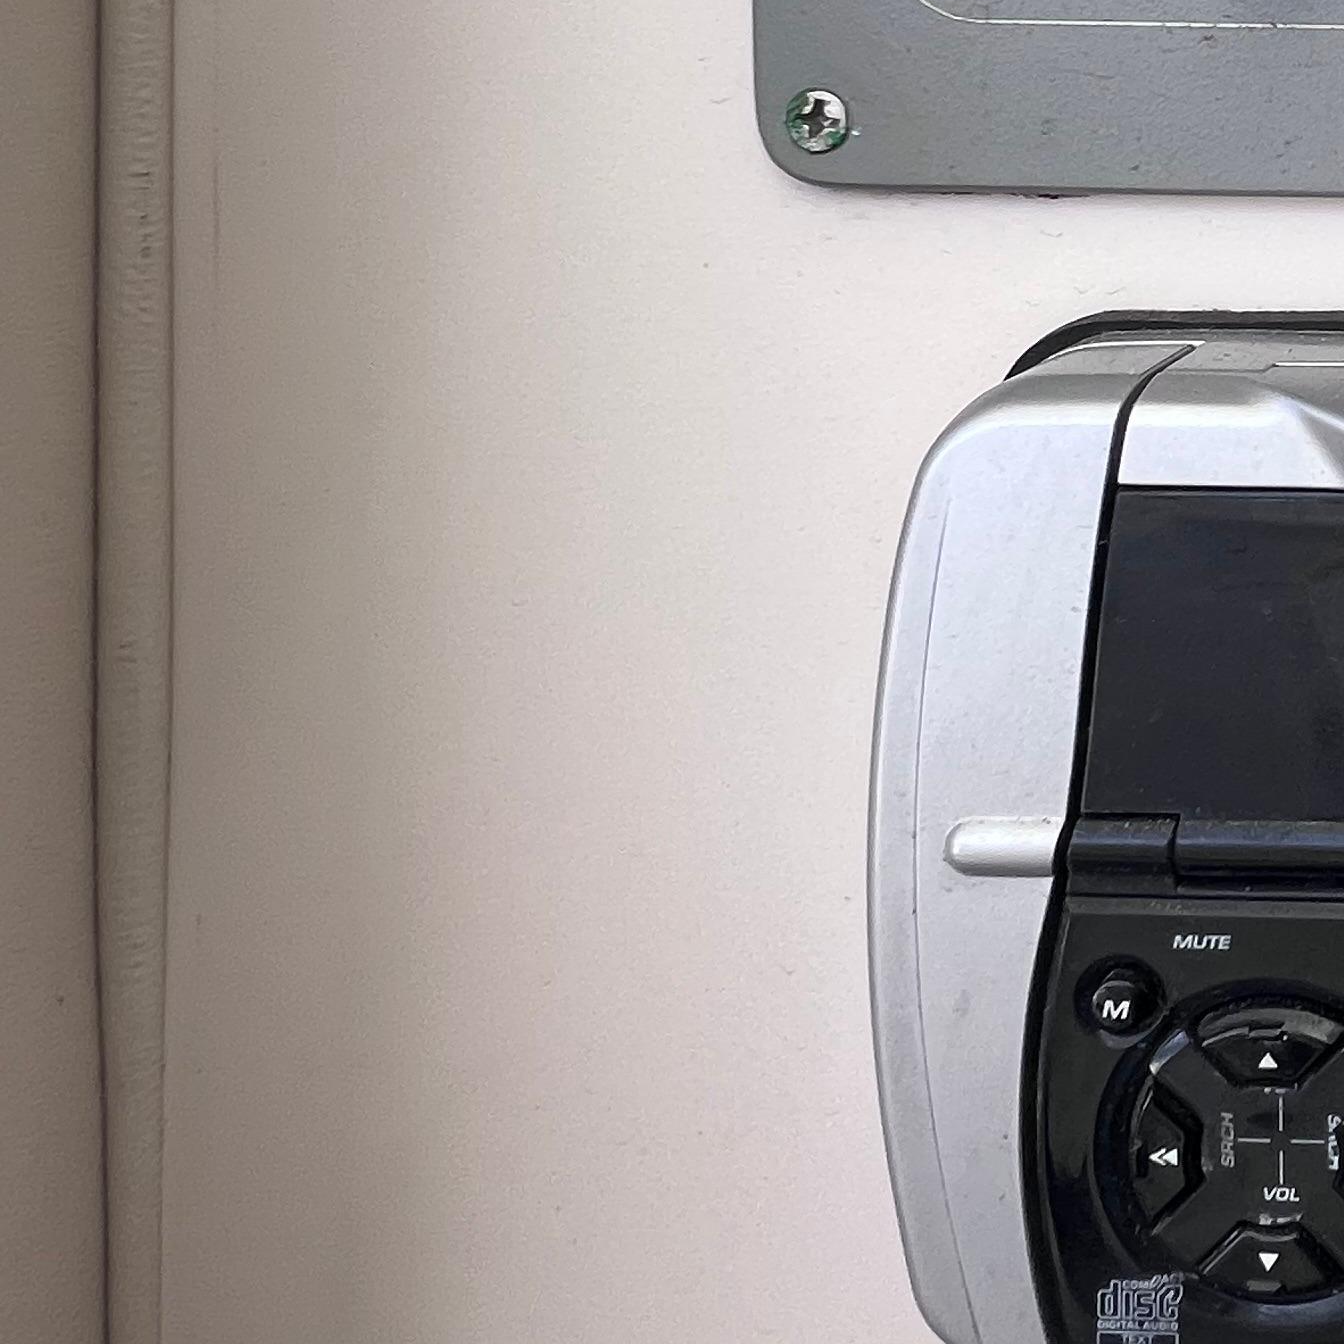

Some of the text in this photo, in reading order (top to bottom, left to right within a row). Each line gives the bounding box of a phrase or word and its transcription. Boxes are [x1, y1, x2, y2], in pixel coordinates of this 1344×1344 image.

[1172, 933, 1232, 951] MUTE
[1101, 999, 1131, 1021] M
[1263, 1186, 1300, 1202] VOL
